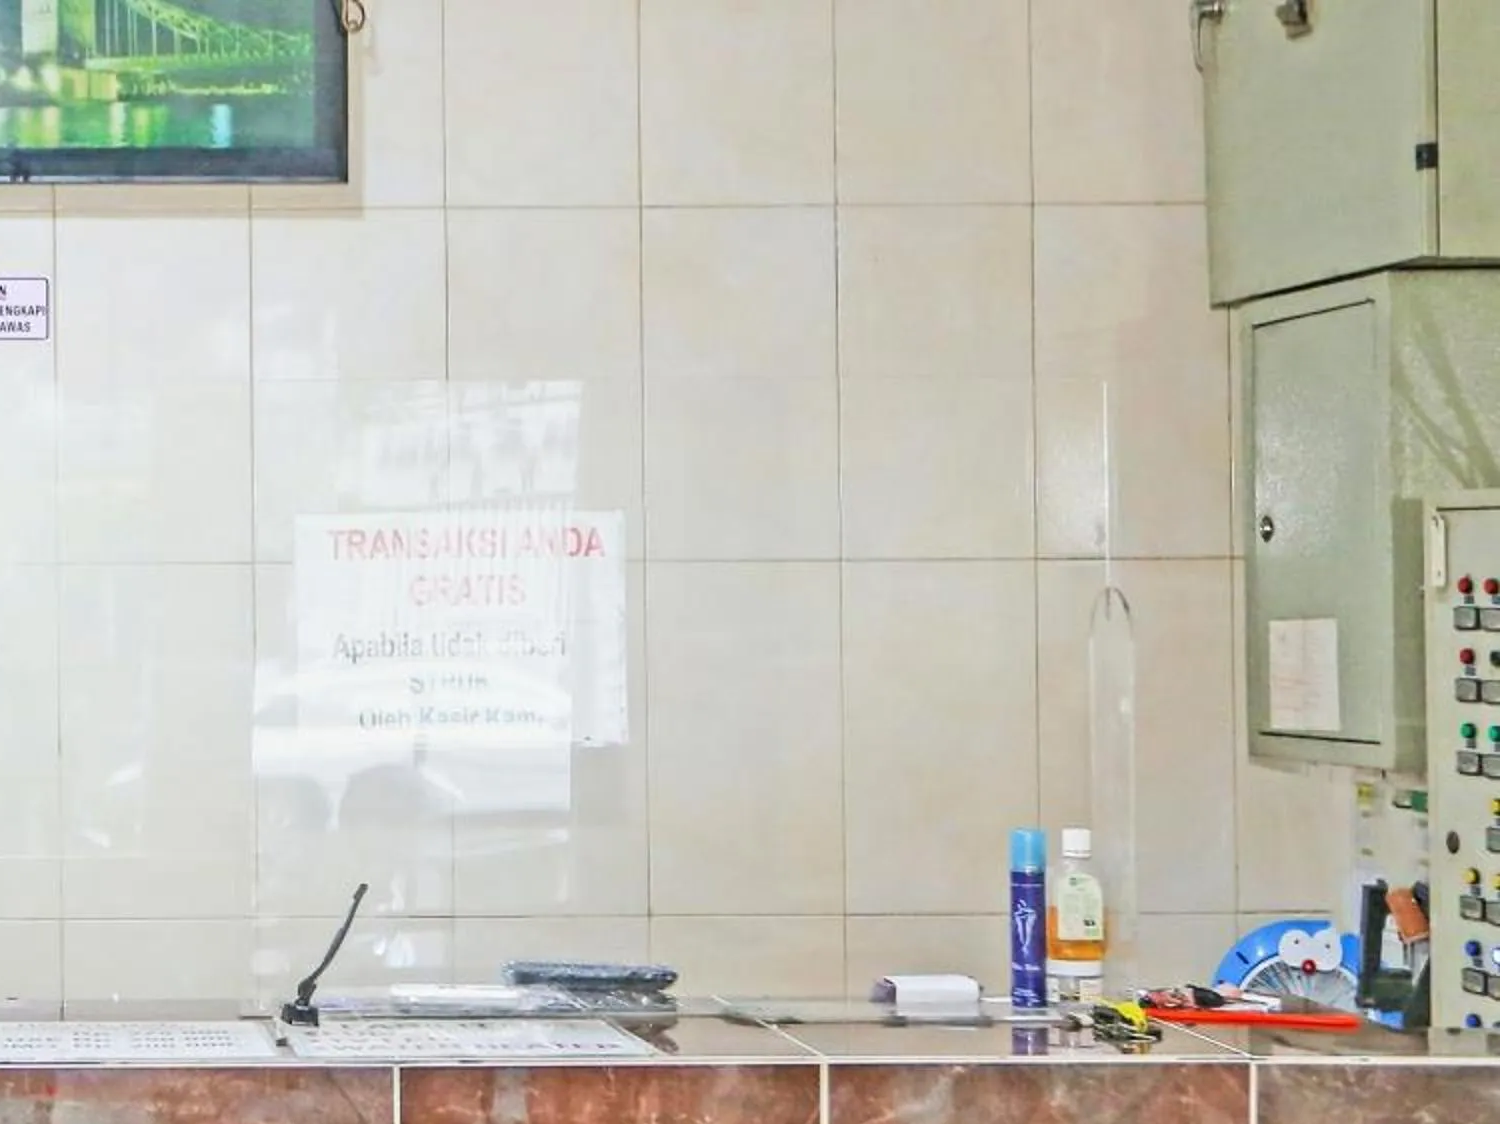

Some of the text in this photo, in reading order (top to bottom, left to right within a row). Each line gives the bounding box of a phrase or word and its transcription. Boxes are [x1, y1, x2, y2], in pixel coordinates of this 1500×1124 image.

[326, 526, 607, 560] TRANSAKSI ANDA
[409, 573, 527, 606] GRATIS
[333, 632, 425, 664] Apabila
